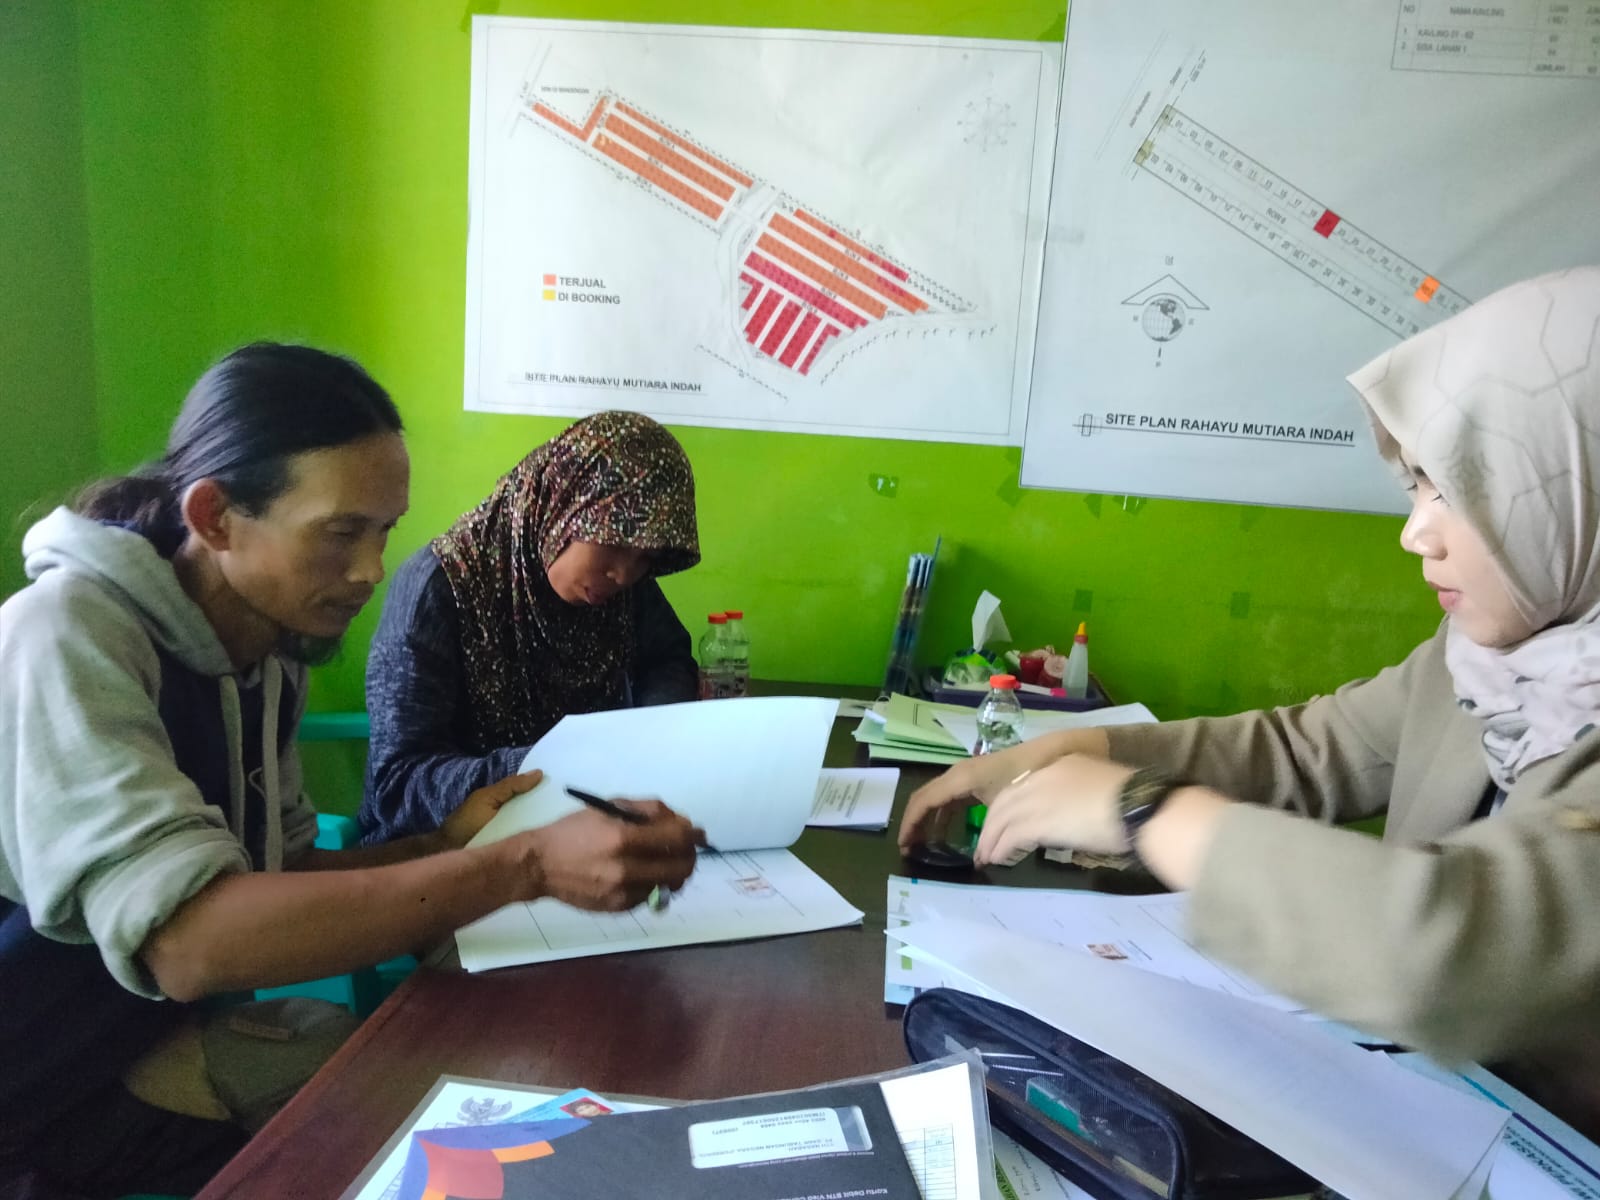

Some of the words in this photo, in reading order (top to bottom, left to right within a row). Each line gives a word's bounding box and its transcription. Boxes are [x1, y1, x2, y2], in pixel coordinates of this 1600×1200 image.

[559, 276, 606, 289] TERJUAL
[558, 292, 569, 302] DI
[571, 293, 620, 305] BOOKING
[578, 376, 620, 387] RAHAYU
[623, 378, 668, 391] MUTIARA
[670, 381, 702, 393] INDAH
[1105, 413, 1136, 426] SITE
[1139, 415, 1177, 430] PLAN
[1180, 418, 1239, 434] RAHAYU
[1242, 423, 1306, 439] MUTIARA
[1309, 427, 1355, 442] INDAH
